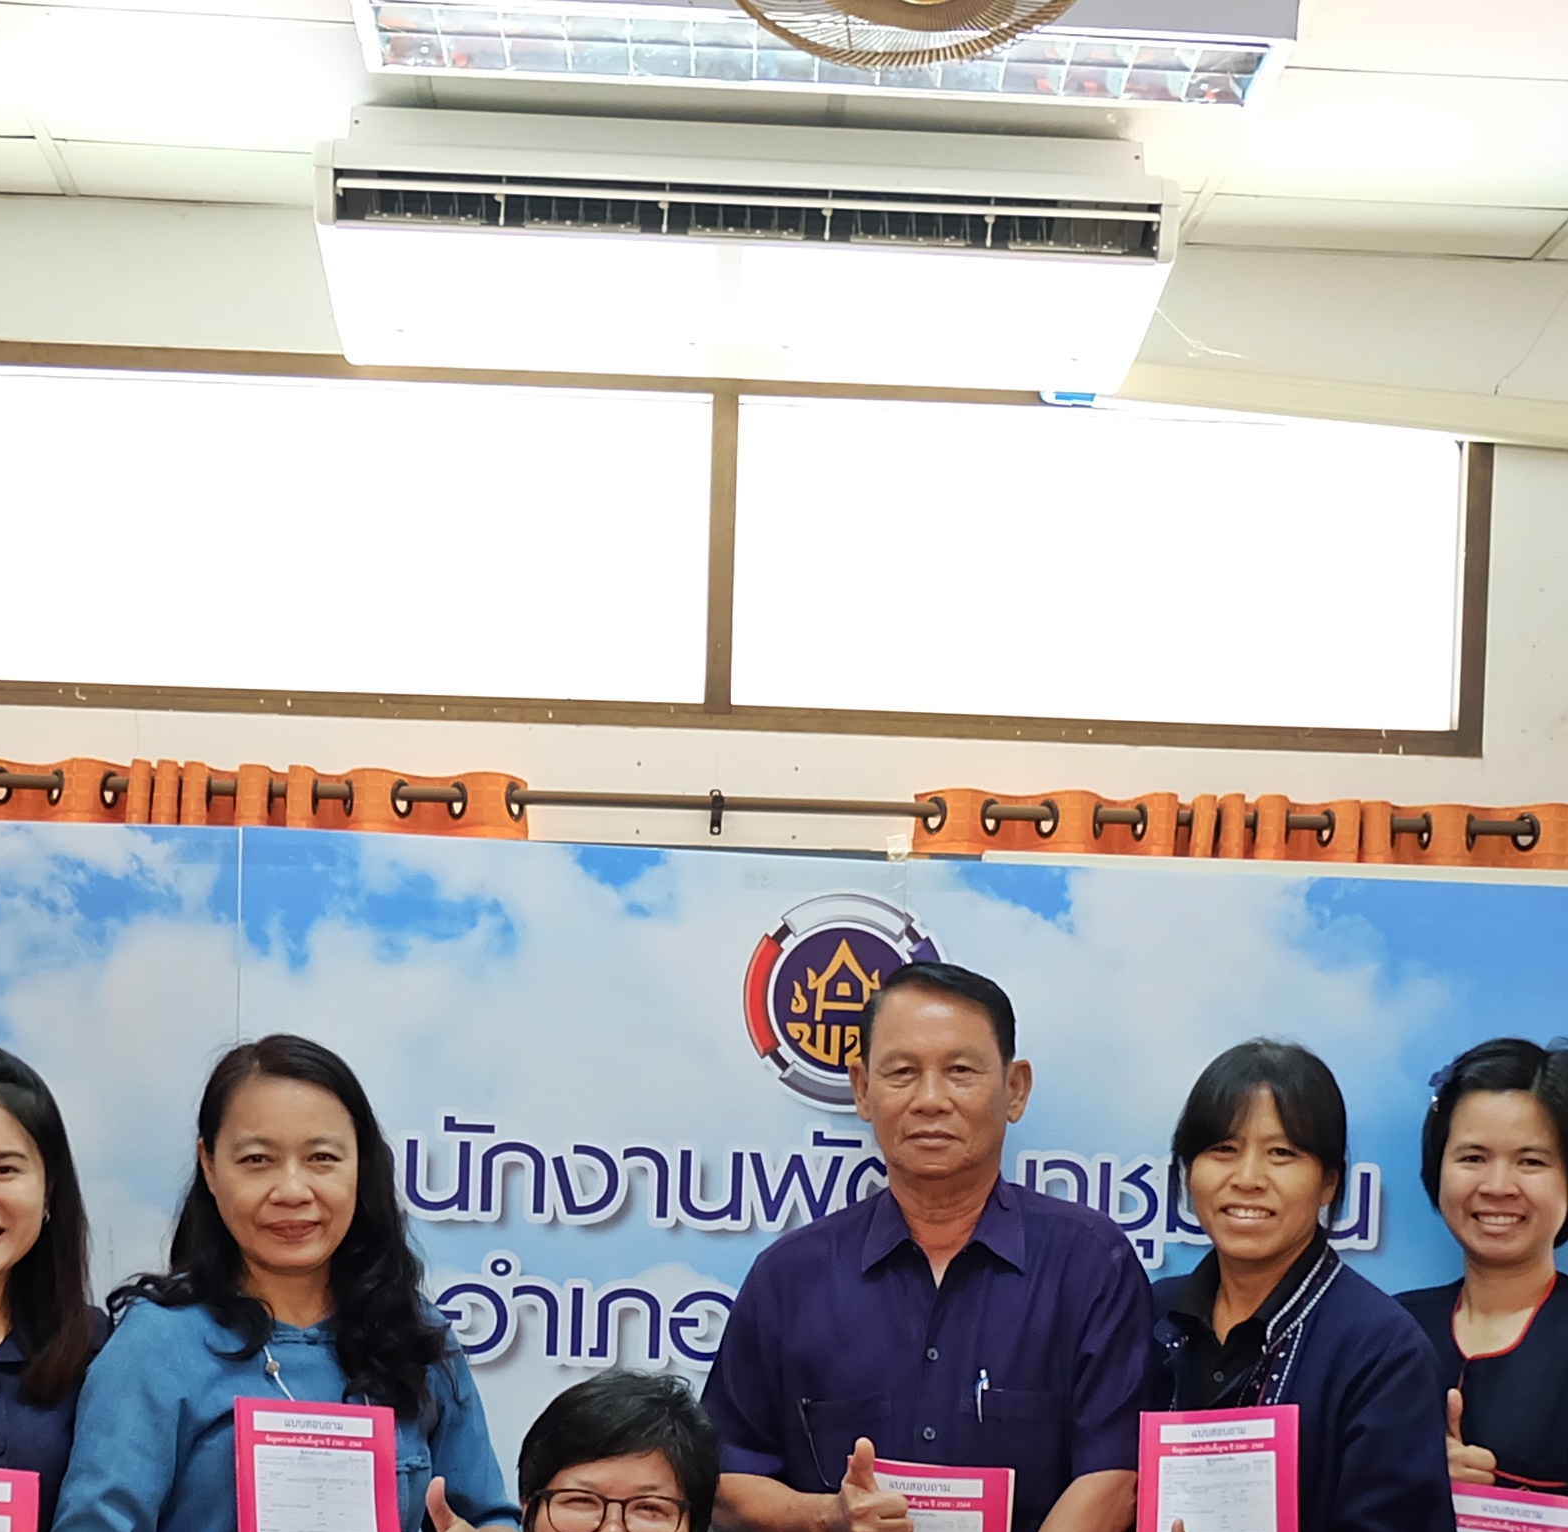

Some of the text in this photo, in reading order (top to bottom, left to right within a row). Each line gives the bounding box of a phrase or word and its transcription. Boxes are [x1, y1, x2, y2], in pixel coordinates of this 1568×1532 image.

[284, 1418, 343, 1431] แบบสอบถาม
[889, 1480, 951, 1492] แบบสอบถาม
